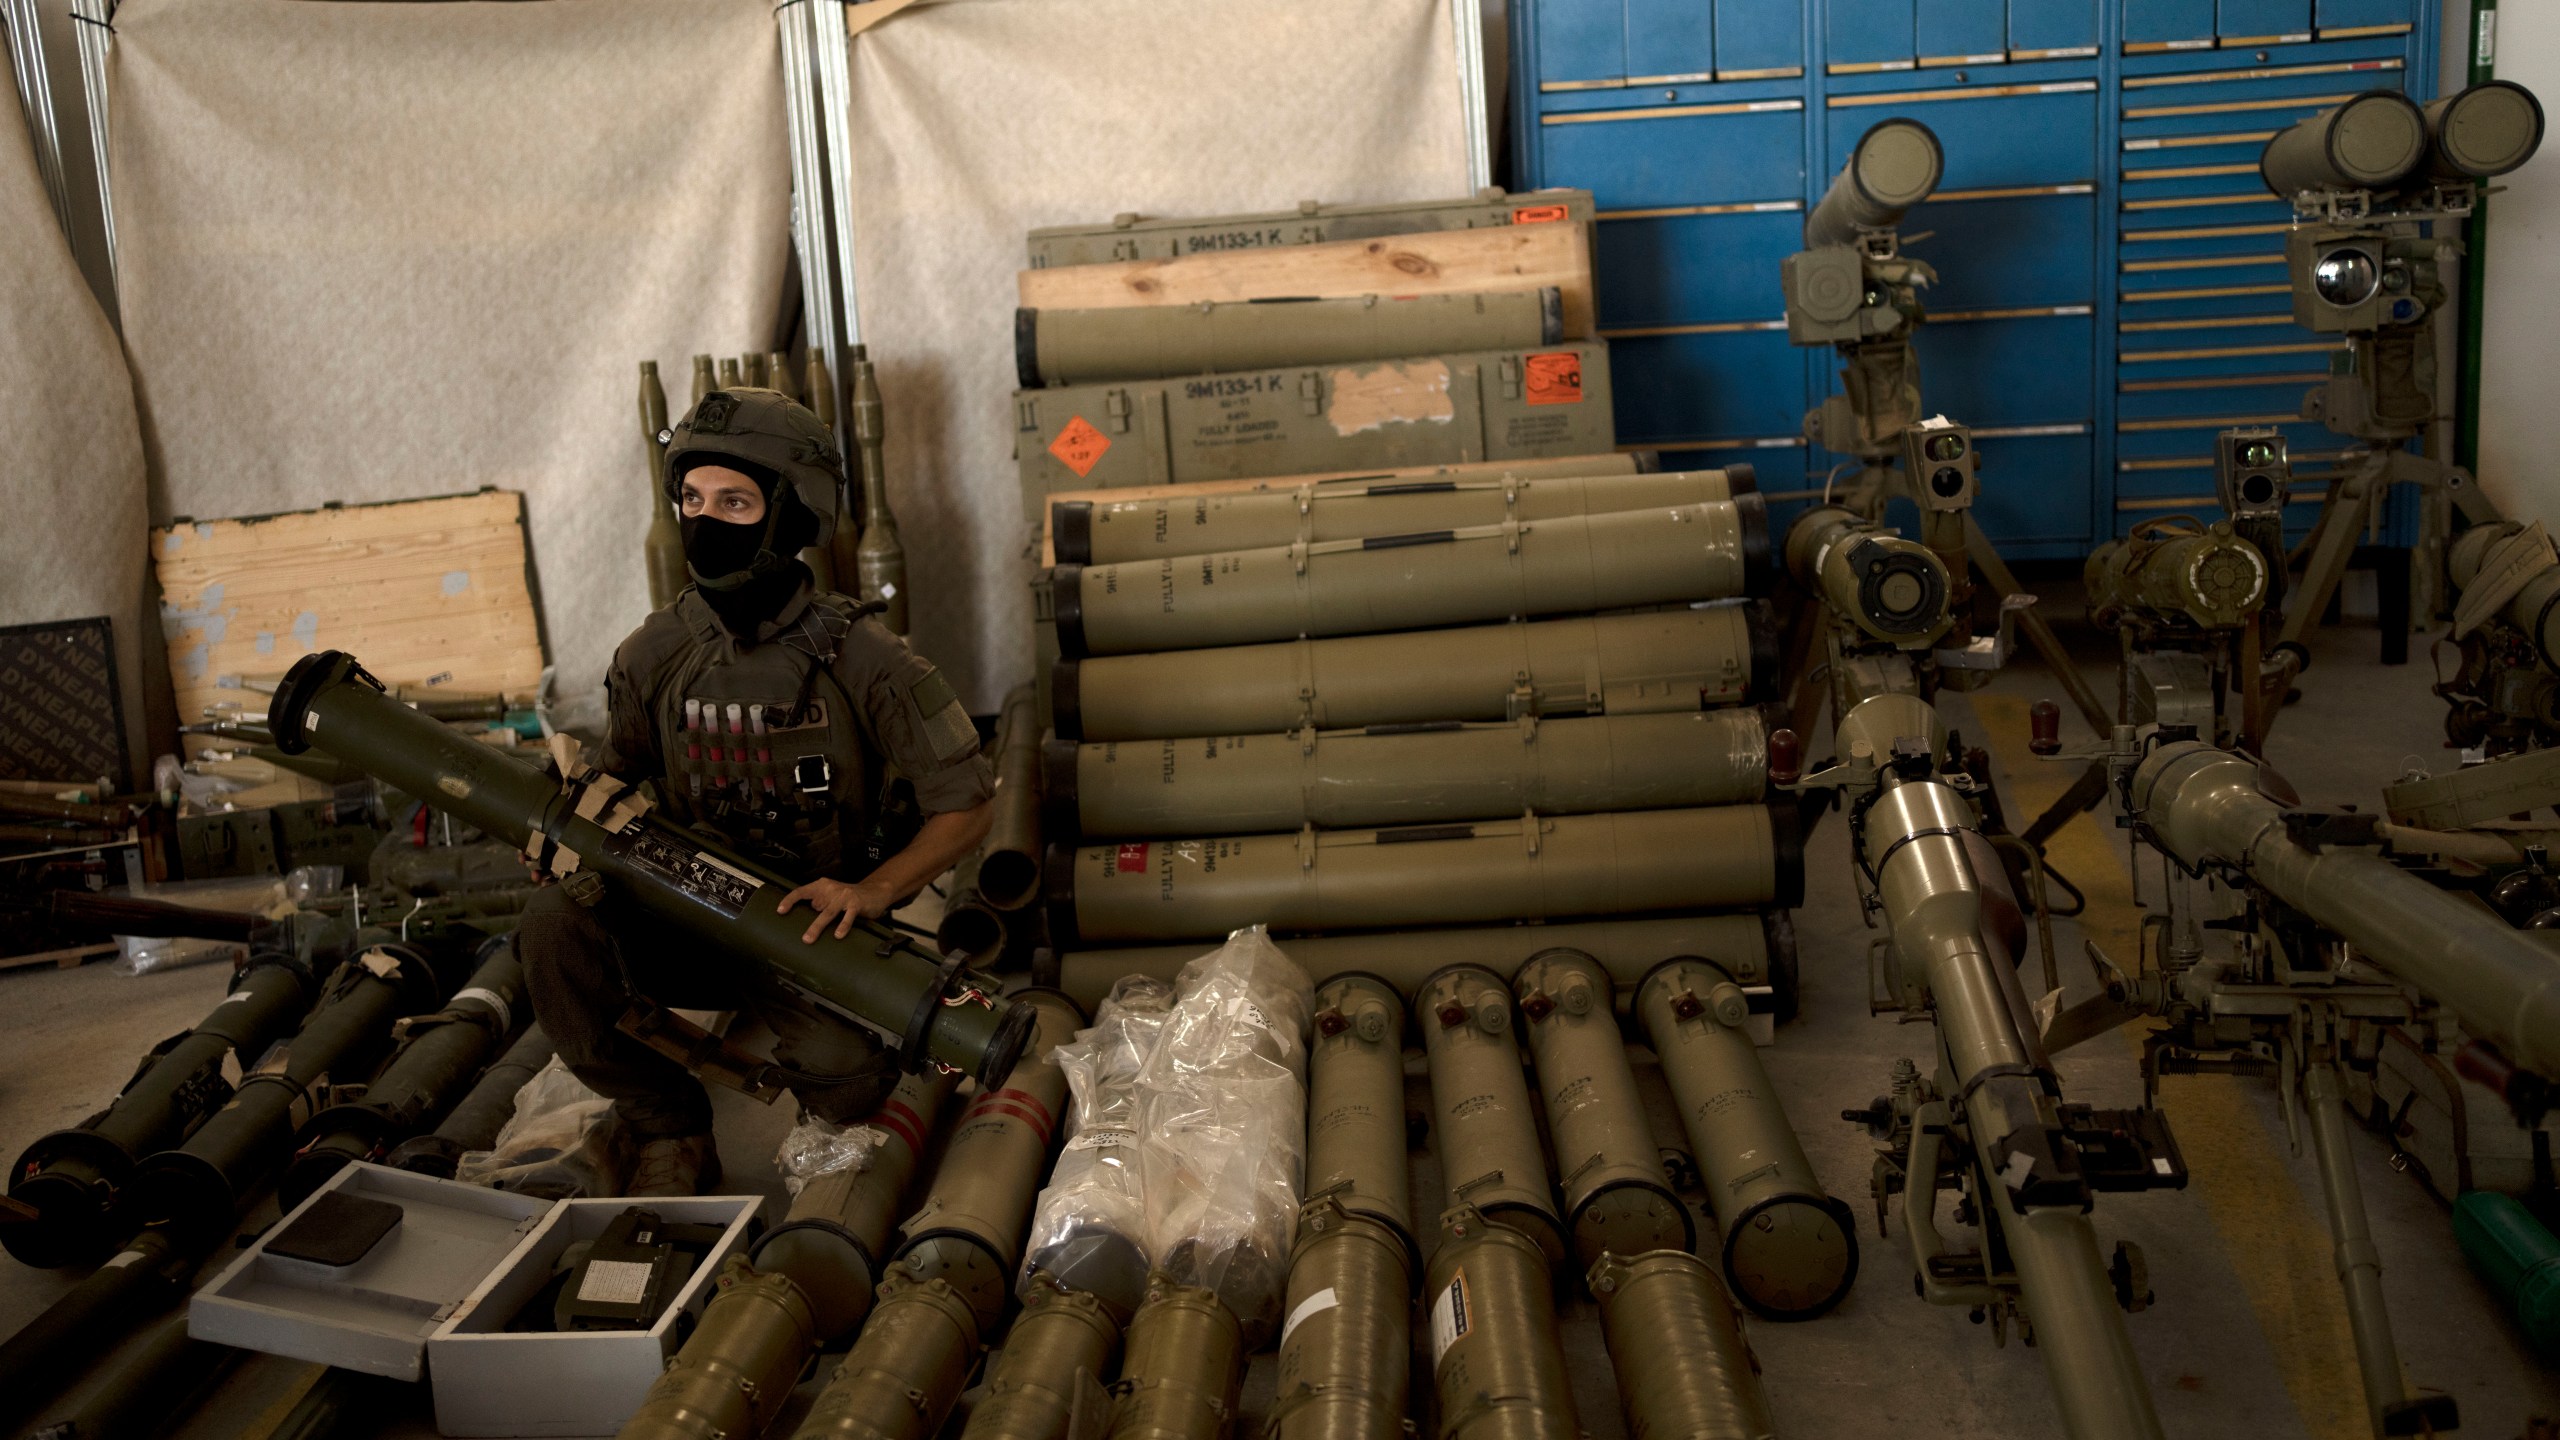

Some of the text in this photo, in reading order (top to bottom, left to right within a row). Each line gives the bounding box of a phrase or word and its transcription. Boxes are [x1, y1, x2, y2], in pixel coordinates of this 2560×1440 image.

[1268, 227, 1282, 245] K
[1269, 374, 1283, 393] K
[1162, 574, 1175, 614] FULLY
[1162, 859, 1174, 901] FULLY
